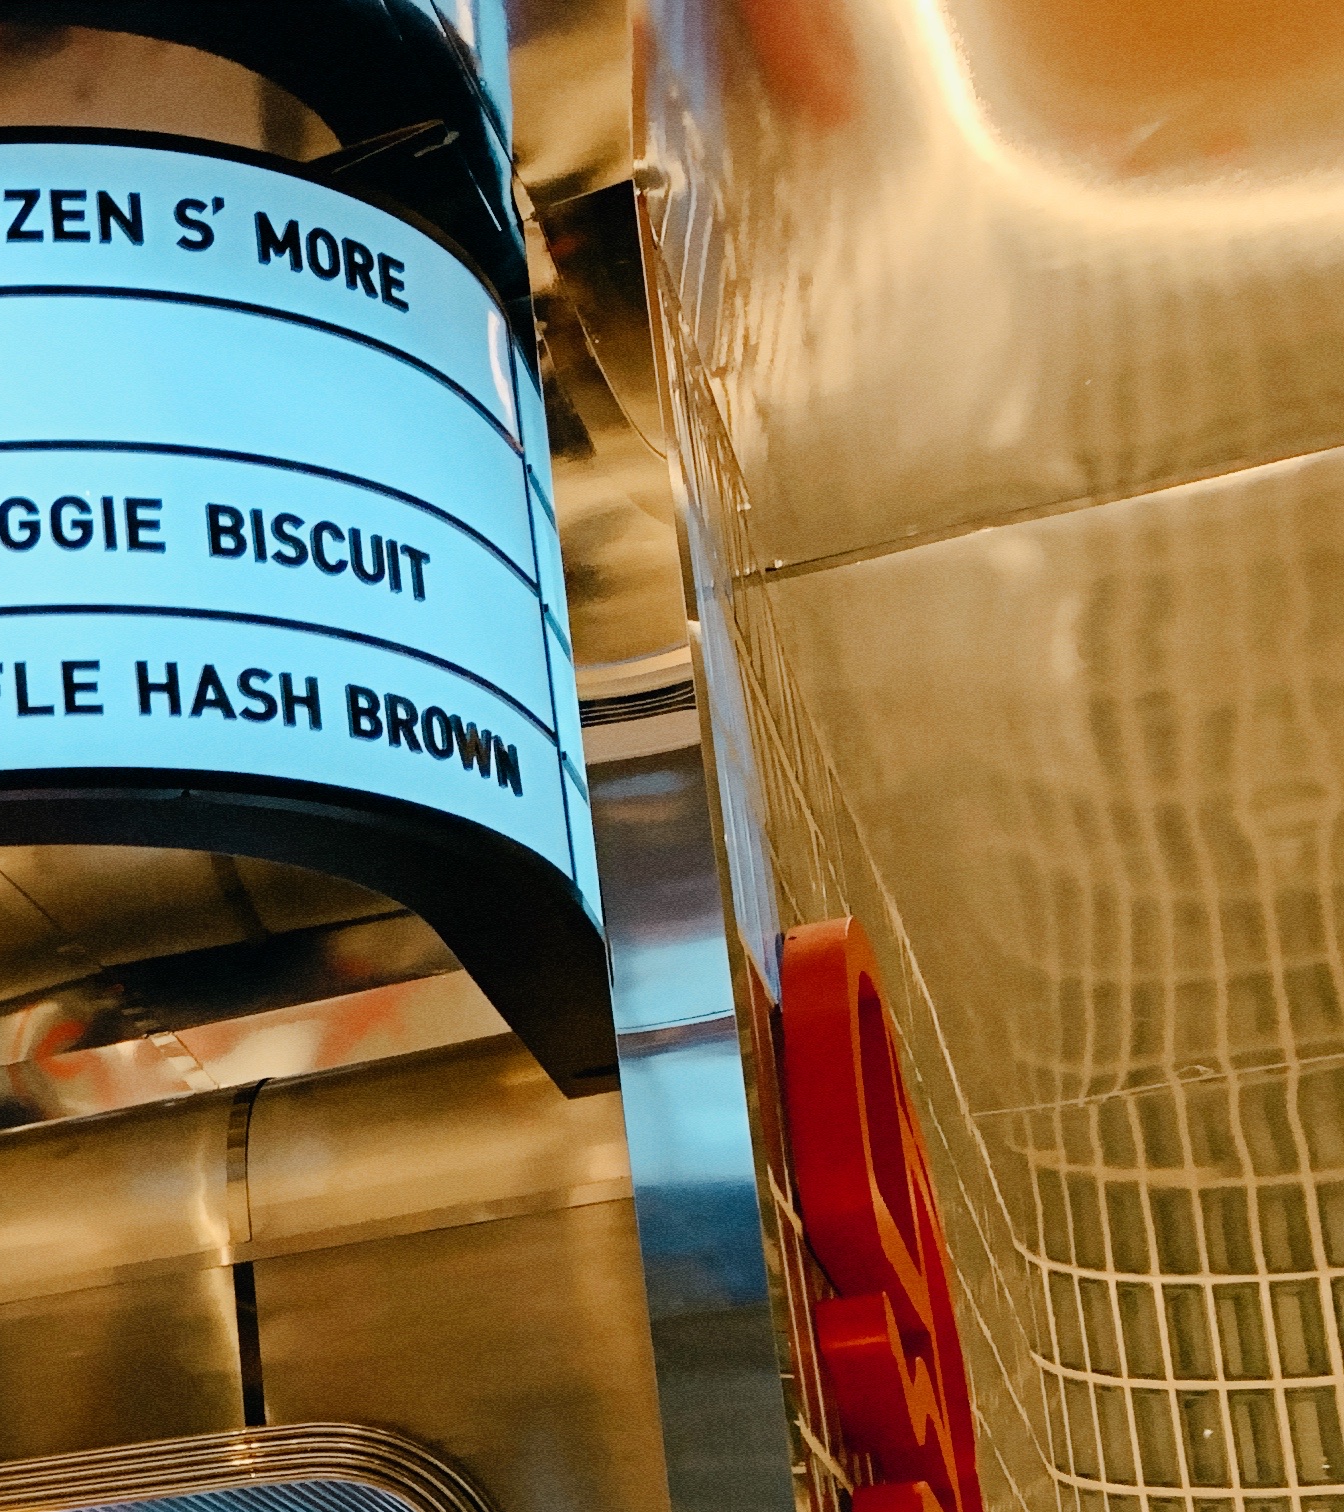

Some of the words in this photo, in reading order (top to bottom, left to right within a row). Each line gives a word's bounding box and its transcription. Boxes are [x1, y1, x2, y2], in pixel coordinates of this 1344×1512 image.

[173, 196, 227, 253] S'
[255, 210, 410, 313] MORE
[206, 504, 431, 601] BISCUIT
[135, 662, 322, 731] HASH
[346, 683, 523, 797] BROWN
